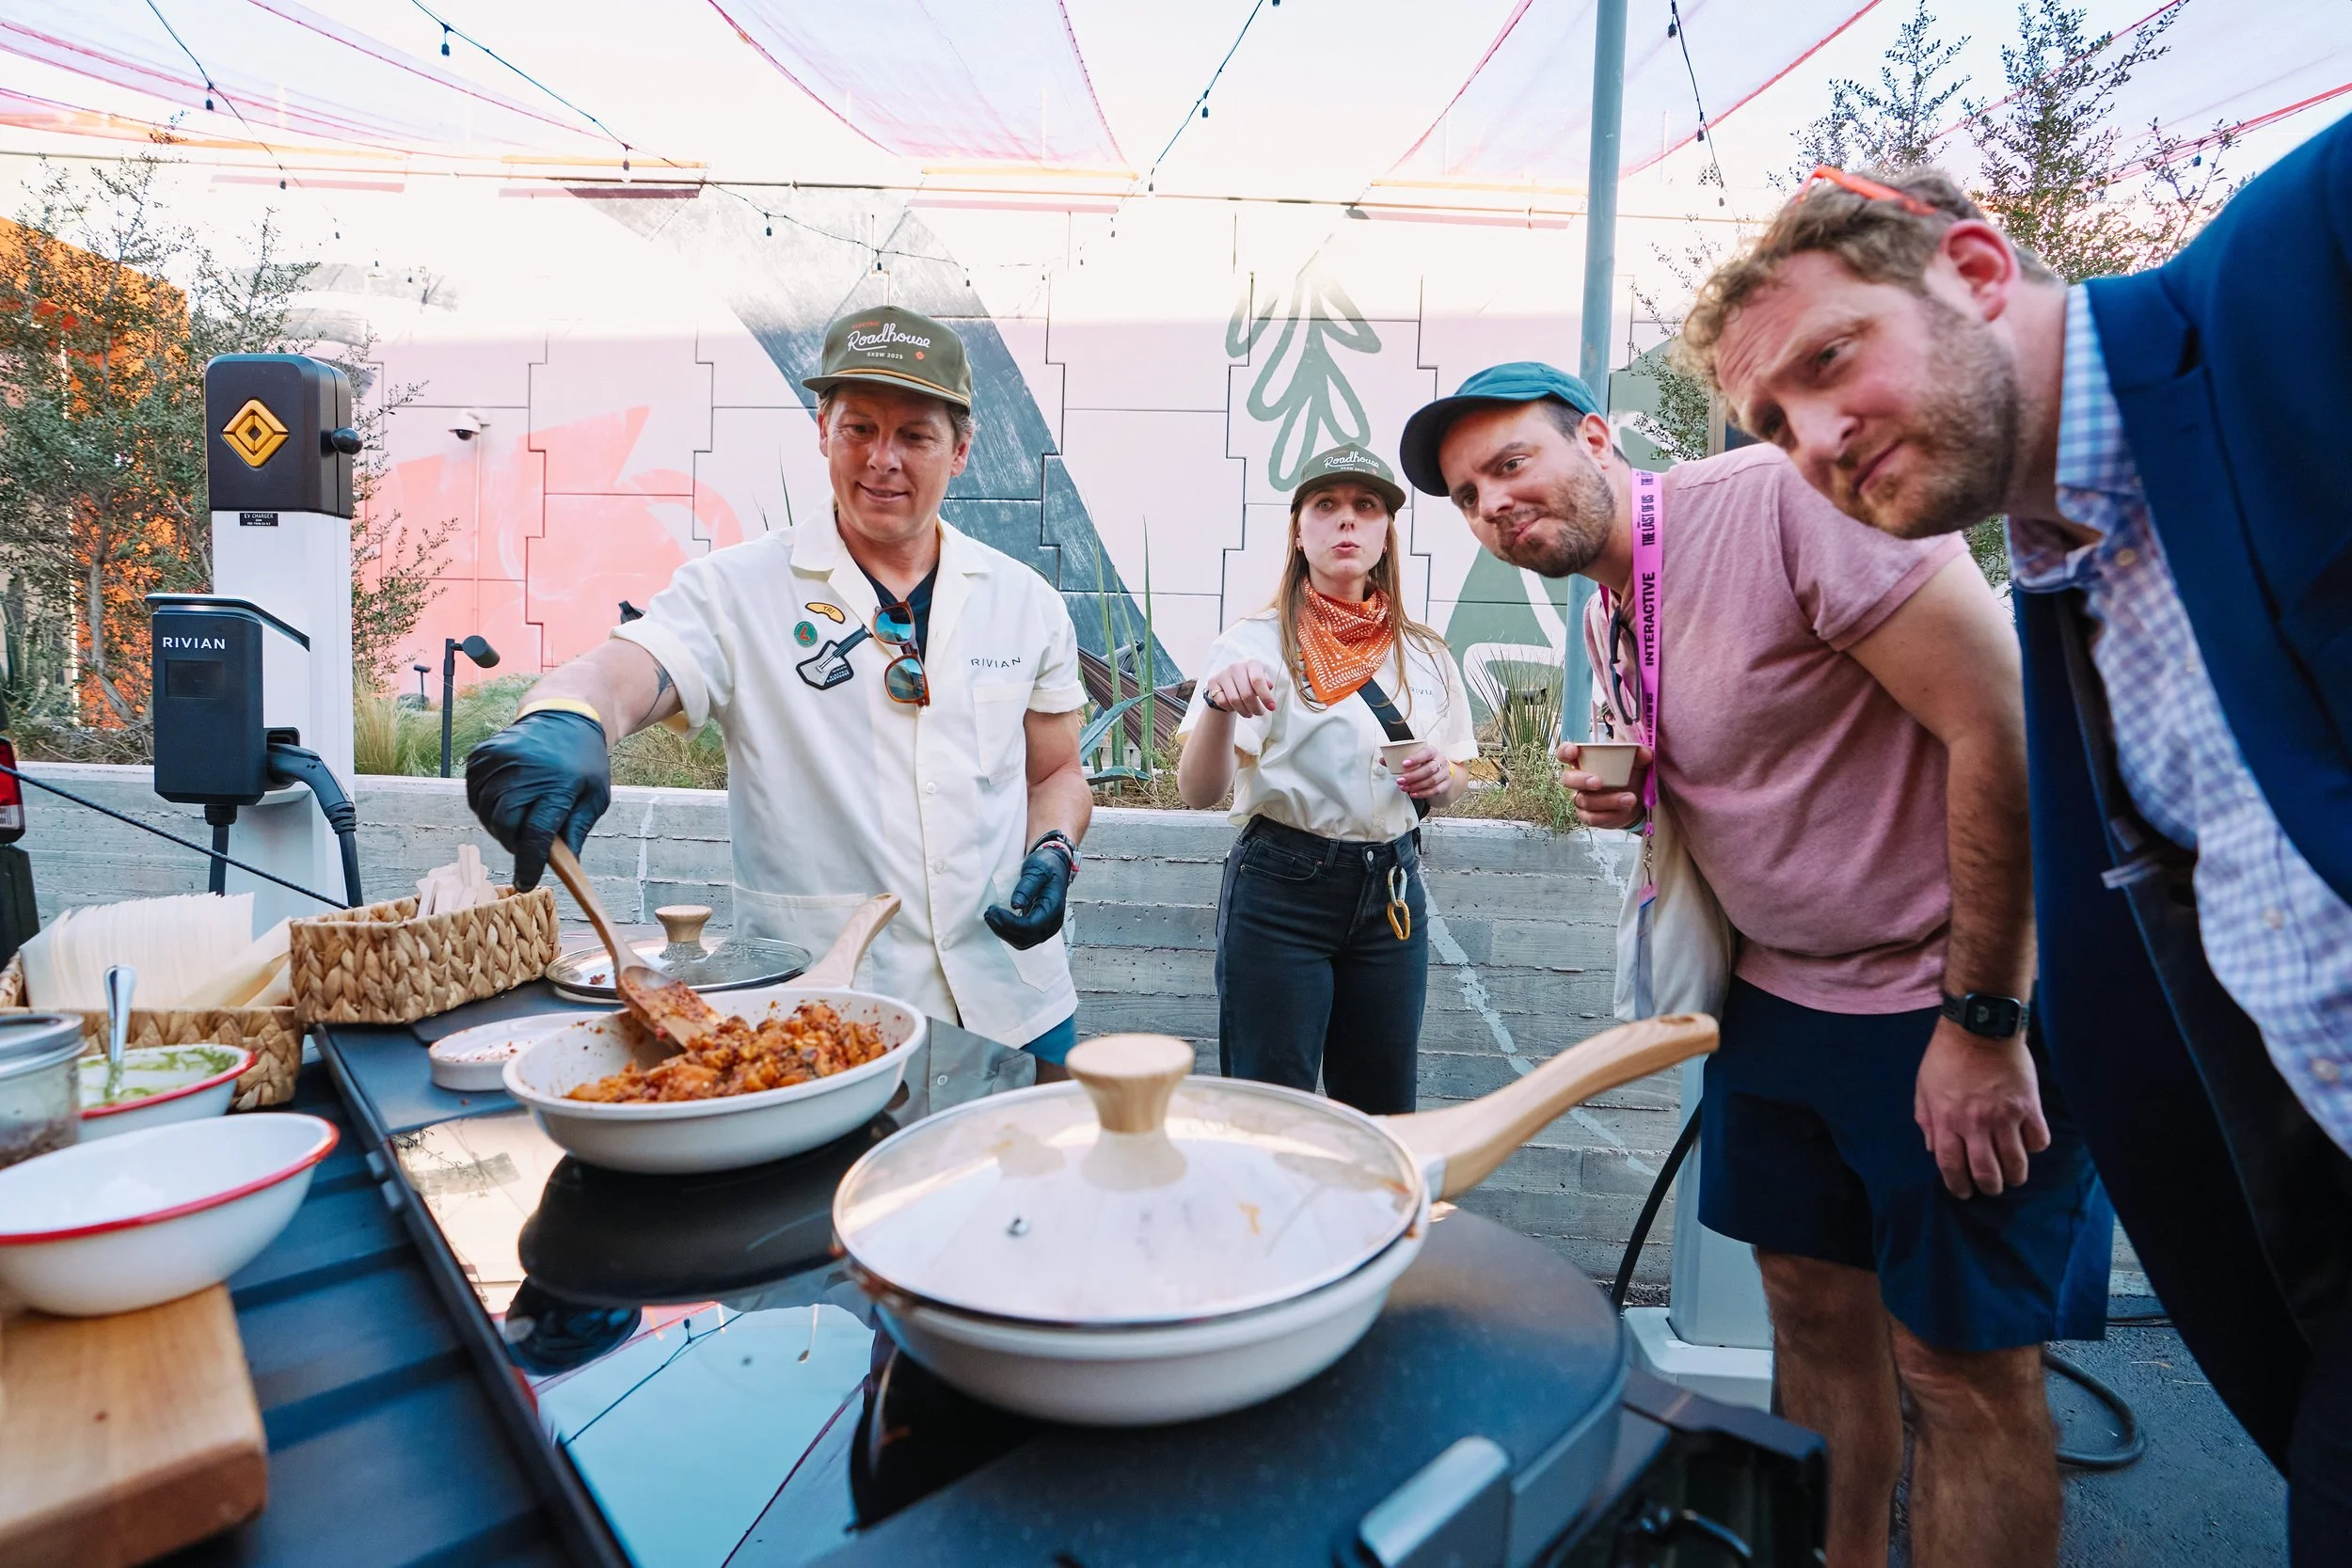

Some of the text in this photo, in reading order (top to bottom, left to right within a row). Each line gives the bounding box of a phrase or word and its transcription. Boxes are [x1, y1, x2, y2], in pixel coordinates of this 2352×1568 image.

[848, 323, 930, 352] Roadhouse
[1323, 451, 1379, 468] Roadhouse
[1641, 495, 1656, 546] THE LAST OF US
[1641, 572, 1656, 667] INTERACTIVE
[163, 637, 226, 650] RIVIAN
[971, 657, 1021, 669] RIVIAN
